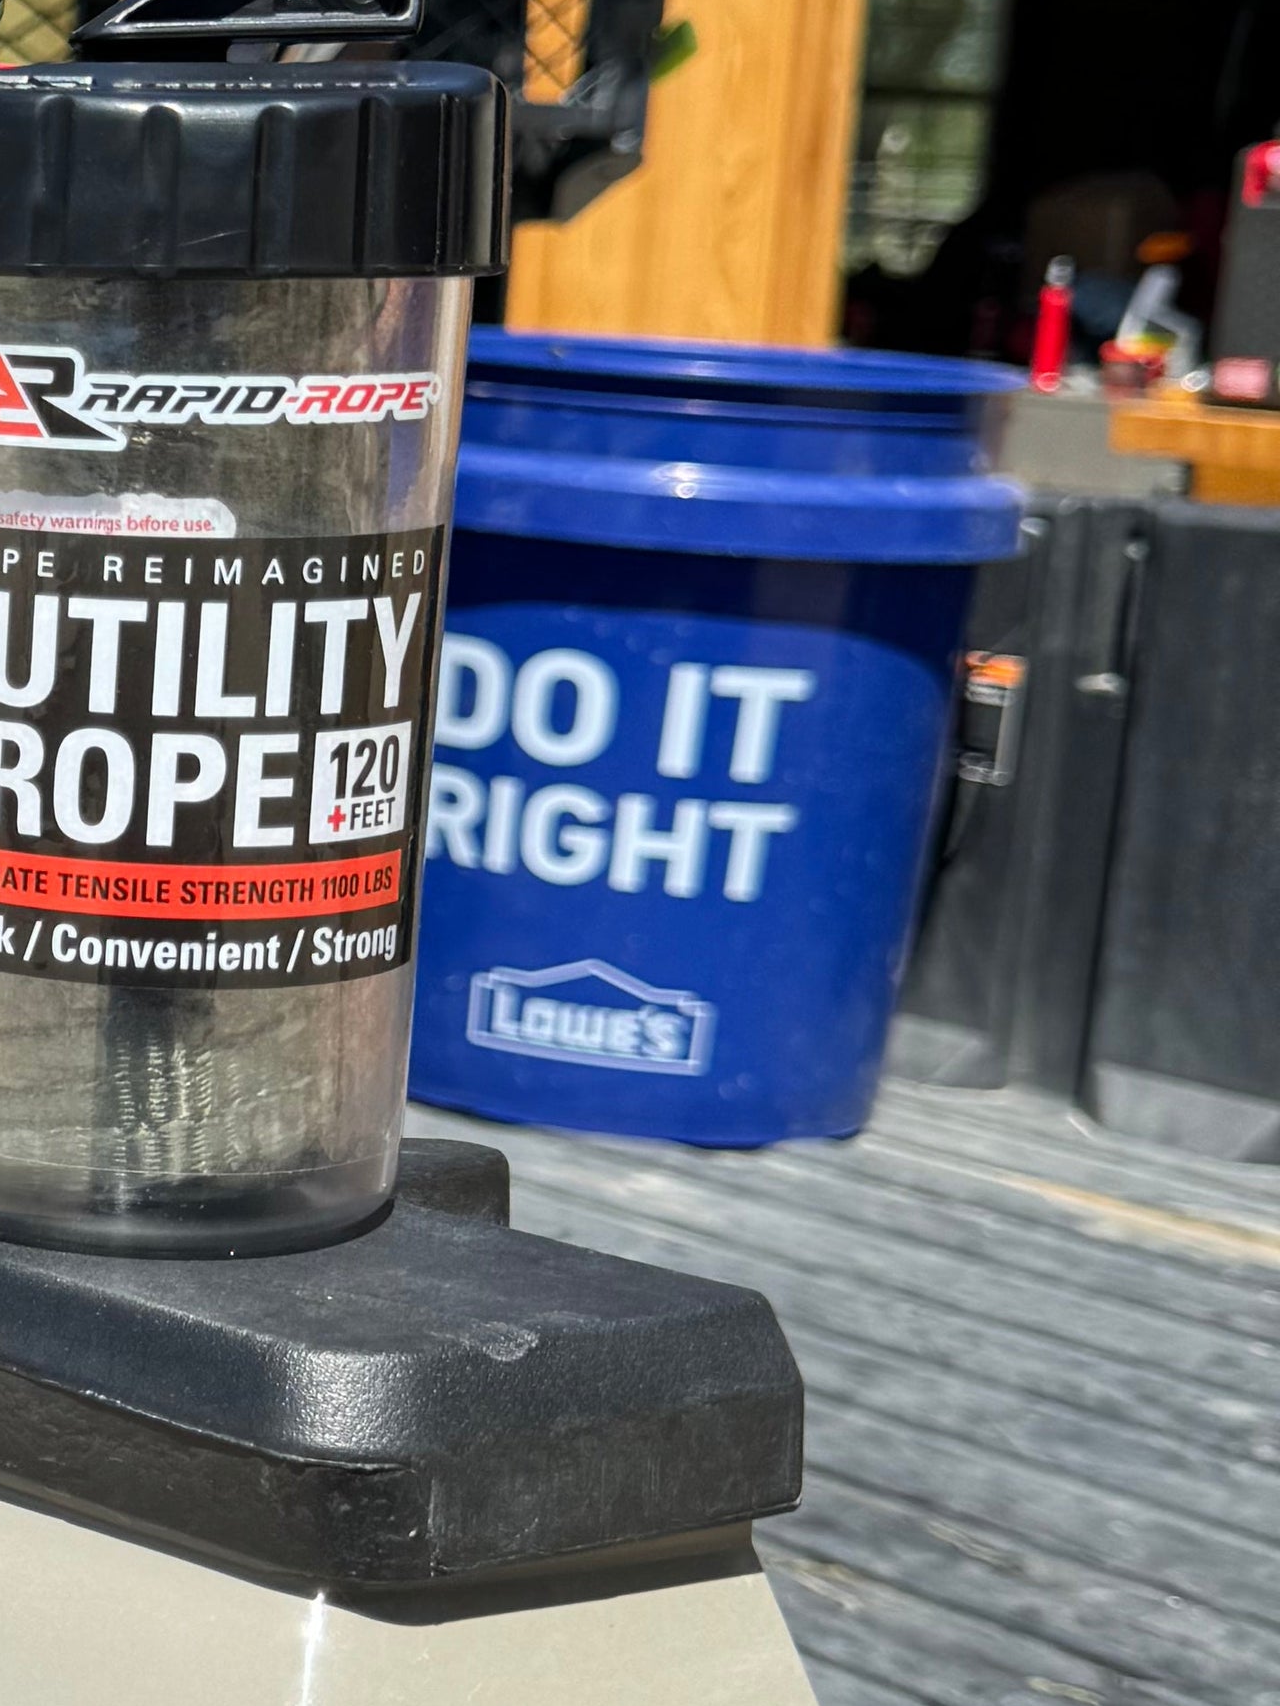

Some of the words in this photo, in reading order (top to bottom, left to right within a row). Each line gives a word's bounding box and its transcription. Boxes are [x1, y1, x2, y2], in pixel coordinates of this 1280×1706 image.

[50, 511, 122, 534] warnings
[184, 518, 216, 532] use.
[103, 550, 425, 585] REIMAGINED
[435, 630, 620, 766] DO
[657, 661, 817, 785] IT
[329, 734, 400, 800] 120
[426, 762, 800, 902] RIGHT
[58, 872, 170, 904] TENSILE
[180, 876, 315, 904] STRENGTH
[321, 875, 359, 900] 1100
[364, 866, 392, 895] LBS
[52, 927, 279, 971] Convenient
[311, 922, 397, 964] Strong
